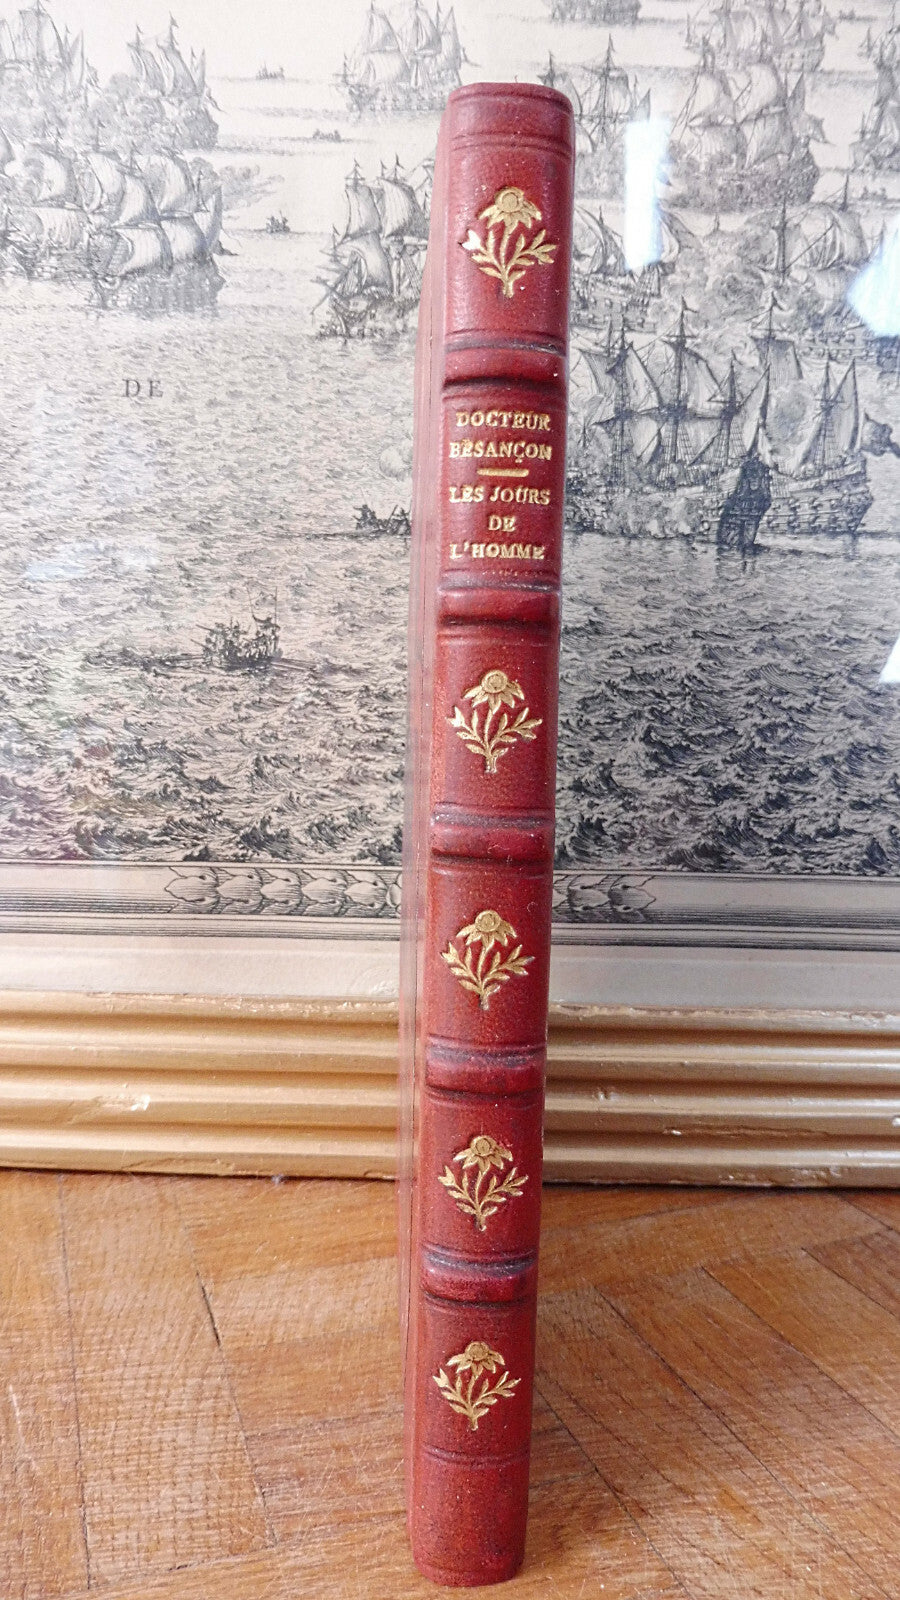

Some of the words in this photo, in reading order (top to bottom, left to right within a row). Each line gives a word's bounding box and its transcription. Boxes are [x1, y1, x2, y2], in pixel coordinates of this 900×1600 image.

[121, 378, 164, 398] DE
[455, 411, 551, 431] DOCTEUR
[449, 439, 552, 463] BESANÇON
[449, 484, 484, 503] LES
[490, 486, 550, 505] JOURS
[488, 515, 516, 532] DE
[449, 543, 545, 560] L'HOMME
